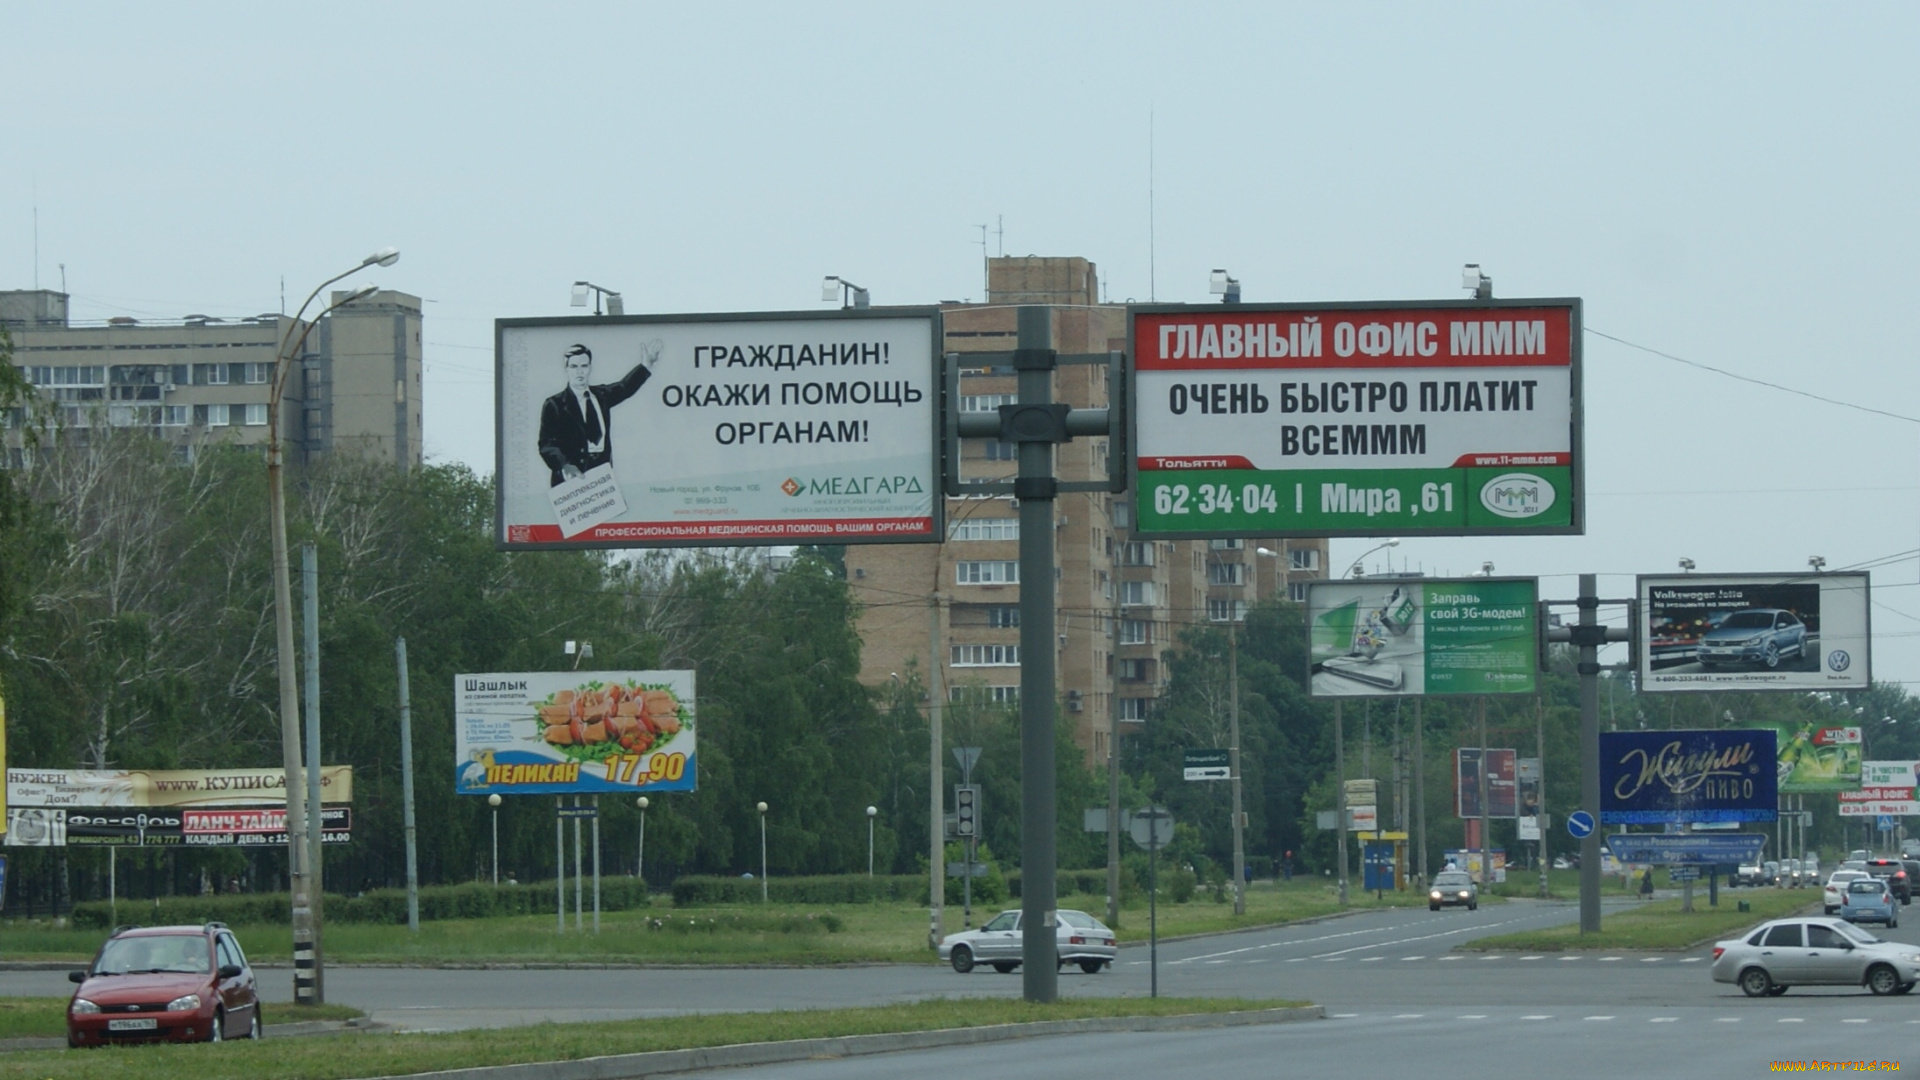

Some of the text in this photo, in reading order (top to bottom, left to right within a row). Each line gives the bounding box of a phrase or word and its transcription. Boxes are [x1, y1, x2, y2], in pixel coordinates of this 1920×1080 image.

[1159, 316, 1547, 360] ГЛАВНЫЙ ОФИС МММ
[694, 342, 890, 371] ГРАЖДАНИН!
[662, 380, 923, 408] ОКАЖИ ПОМОЩЬ
[1169, 380, 1538, 415] ОЧЕНЬ БЫСТРО ПЛАТИТ
[715, 420, 870, 446] ОРГАНАМ!
[1280, 424, 1427, 456] ВСЕМММ
[1156, 457, 1227, 469] Тольятти
[553, 473, 612, 506] комплексная
[650, 485, 675, 494] Новый
[810, 476, 924, 496] МЕДГАРД
[559, 485, 616, 517] диагностика
[1321, 482, 1401, 517] Мира
[569, 498, 616, 525] и лечение
[595, 522, 924, 537] ПРОФЕССИОНАЛЬНАЯ МЕДИЦИНСКАЯ ПОМОЩЬ ВАШИМ ОРГАНАМ
[1430, 592, 1480, 606] Заправь
[1654, 590, 1716, 601] Volkswagen
[1430, 606, 1459, 619] свой
[1461, 606, 1526, 620] 3G-модем!
[465, 679, 528, 691] Шашлык
[8, 772, 67, 785] НУЖЕН
[486, 763, 581, 785] ПЕЛИКАН
[604, 752, 686, 786] 17,90
[44, 794, 77, 805] Дом?
[1706, 779, 1753, 800] ПИВО
[186, 811, 288, 831] ЛАНЧ-ТАЙМ
[68, 835, 139, 844] ПРИМОРСКИЙ 43
[145, 835, 181, 844] 774 777
[185, 833, 234, 845] КАЖДЫЙ
[238, 833, 266, 845] ДЕНЬ
